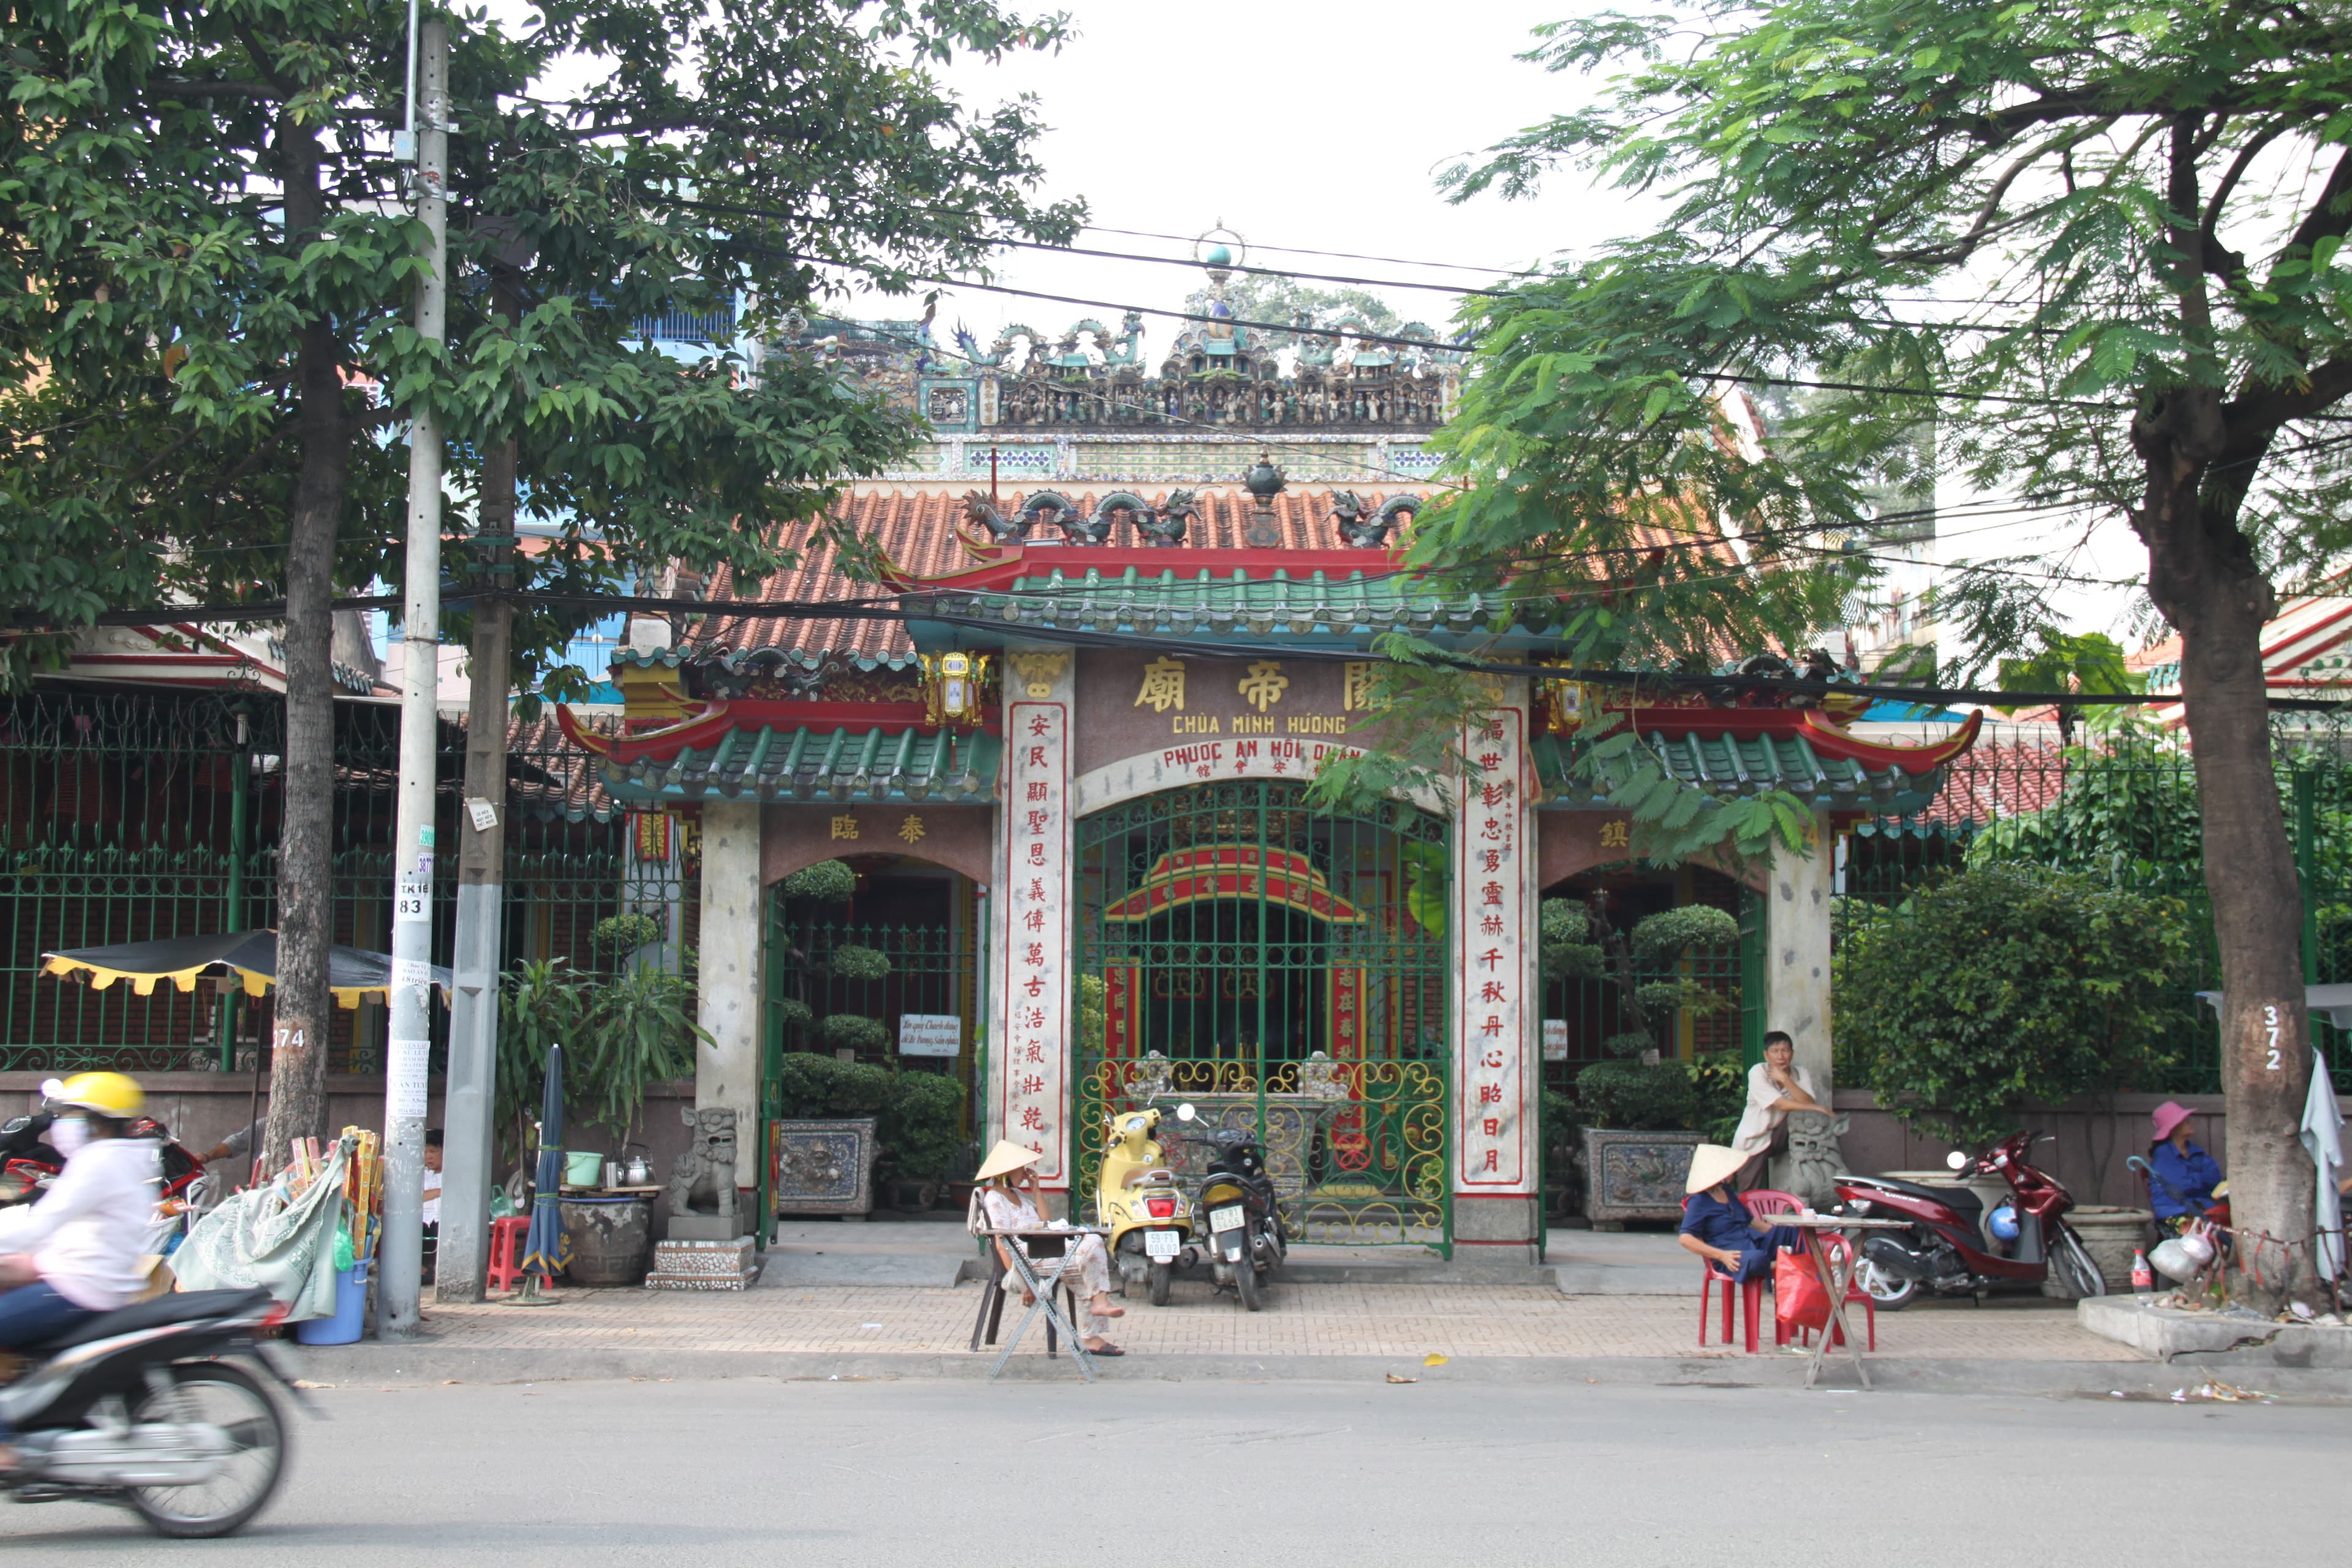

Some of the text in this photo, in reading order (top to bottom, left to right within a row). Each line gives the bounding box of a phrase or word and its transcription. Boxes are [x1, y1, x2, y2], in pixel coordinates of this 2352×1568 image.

[1173, 712, 1220, 734] CHÙA
[1232, 713, 1275, 734] MINH
[1235, 740, 1257, 758] AN
[1270, 739, 1300, 762] HỘI
[2264, 1006, 2281, 1070] 372
